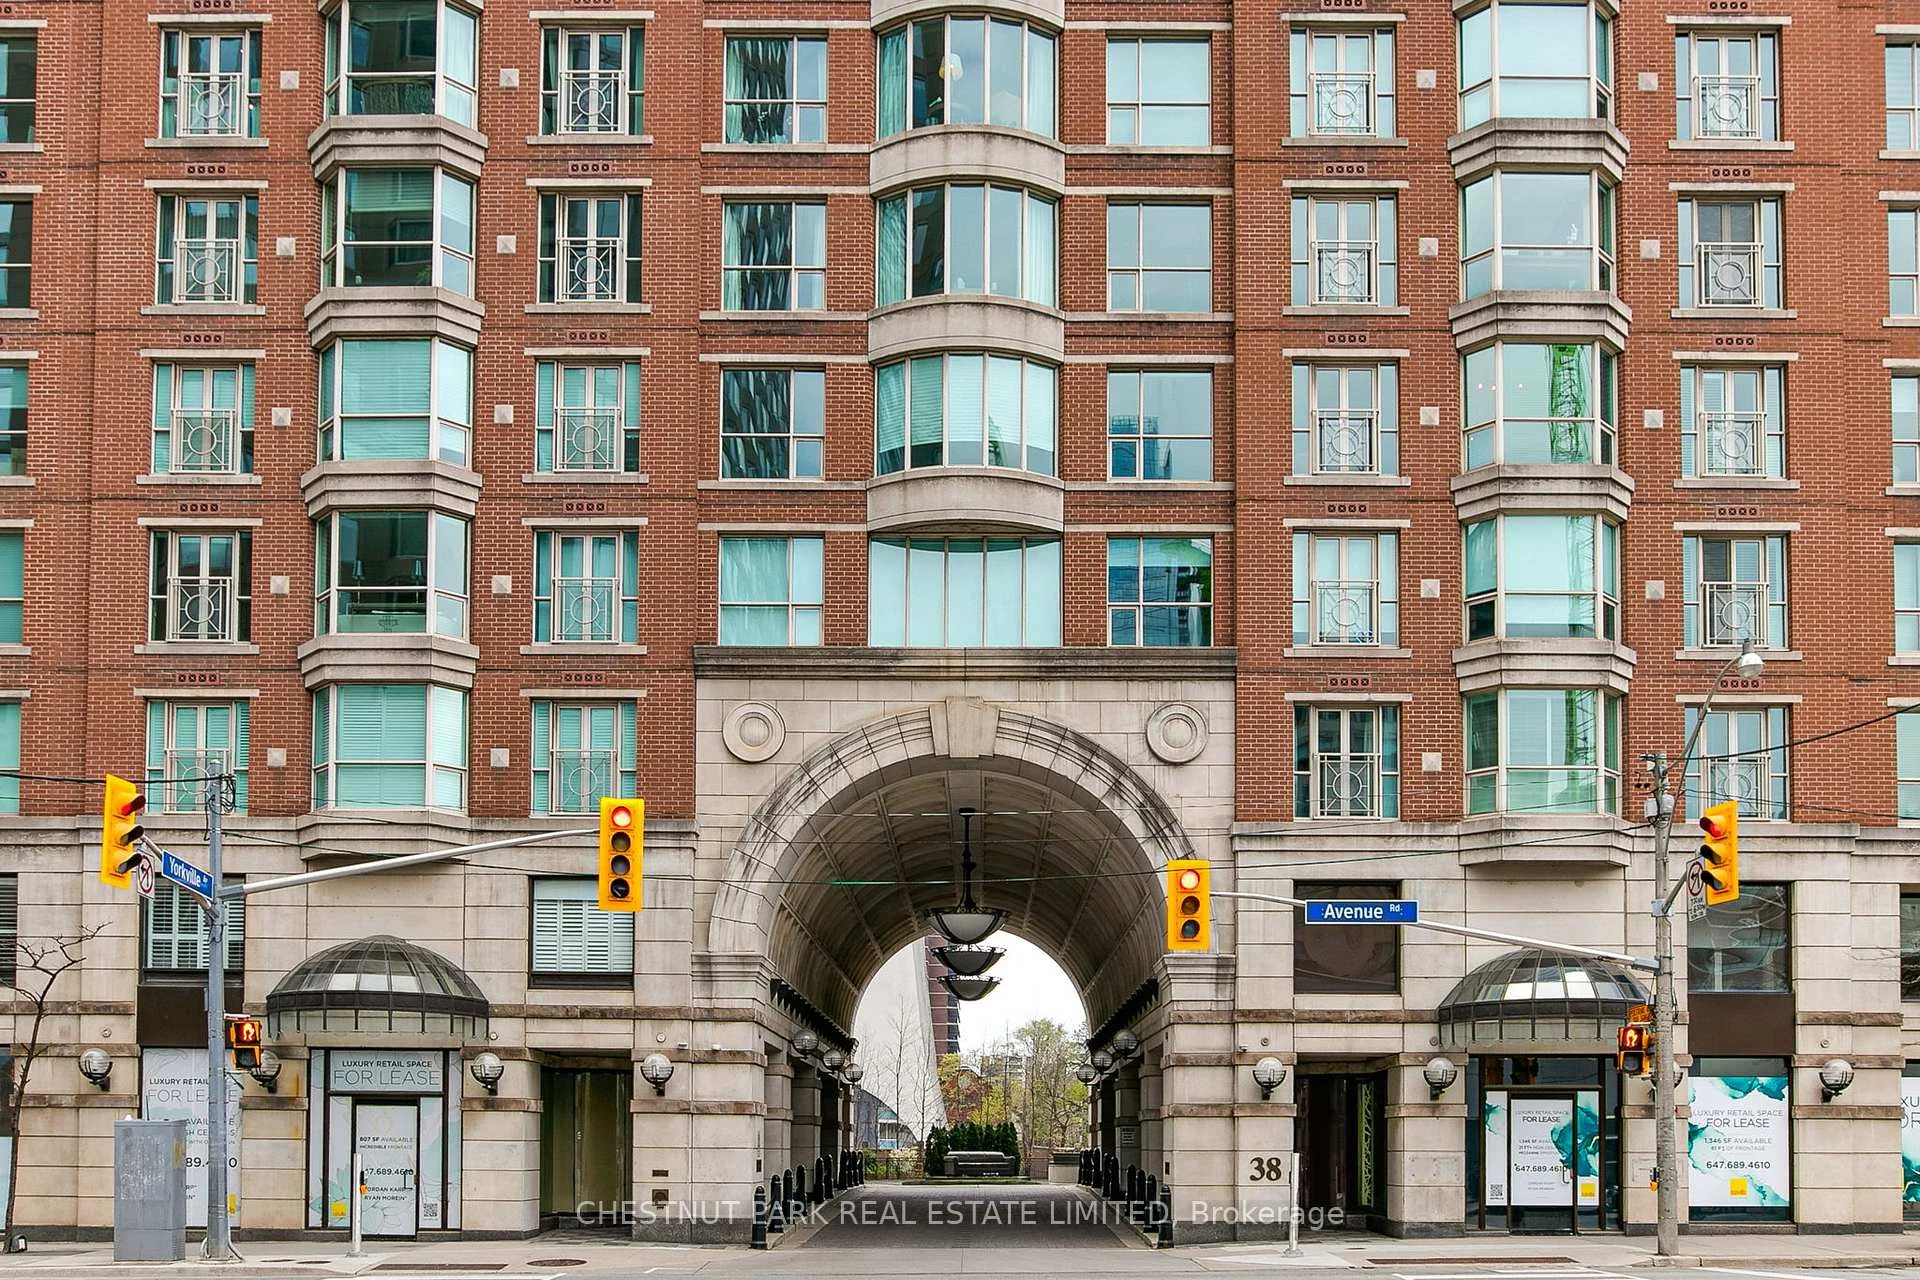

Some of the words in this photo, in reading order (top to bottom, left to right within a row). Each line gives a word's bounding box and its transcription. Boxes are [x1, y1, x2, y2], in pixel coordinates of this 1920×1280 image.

[169, 856, 201, 888] Yorkville
[1324, 903, 1384, 919] Avenue
[342, 1060, 374, 1068] LUXURY
[376, 1060, 405, 1068] RETAIL
[406, 1060, 433, 1068] SPACE
[149, 1078, 181, 1086] LUXURY
[182, 1078, 209, 1086] RETAIL
[333, 1070, 373, 1085] FOR
[379, 1070, 441, 1086] LEASE
[147, 1089, 182, 1103] FOR
[186, 1089, 239, 1103] LEE
[1693, 1109, 1725, 1117] LUXURY
[1727, 1109, 1755, 1117] RETAIL
[1756, 1109, 1784, 1117] SPACE
[186, 1118, 235, 1126] AVAILE
[1706, 1118, 1730, 1128] FOR
[1733, 1118, 1770, 1128] LEASE
[1734, 1137, 1773, 1145] AVAILABLE
[1249, 1157, 1282, 1182] 38
[1706, 1161, 1771, 1169] 647.689.4610
